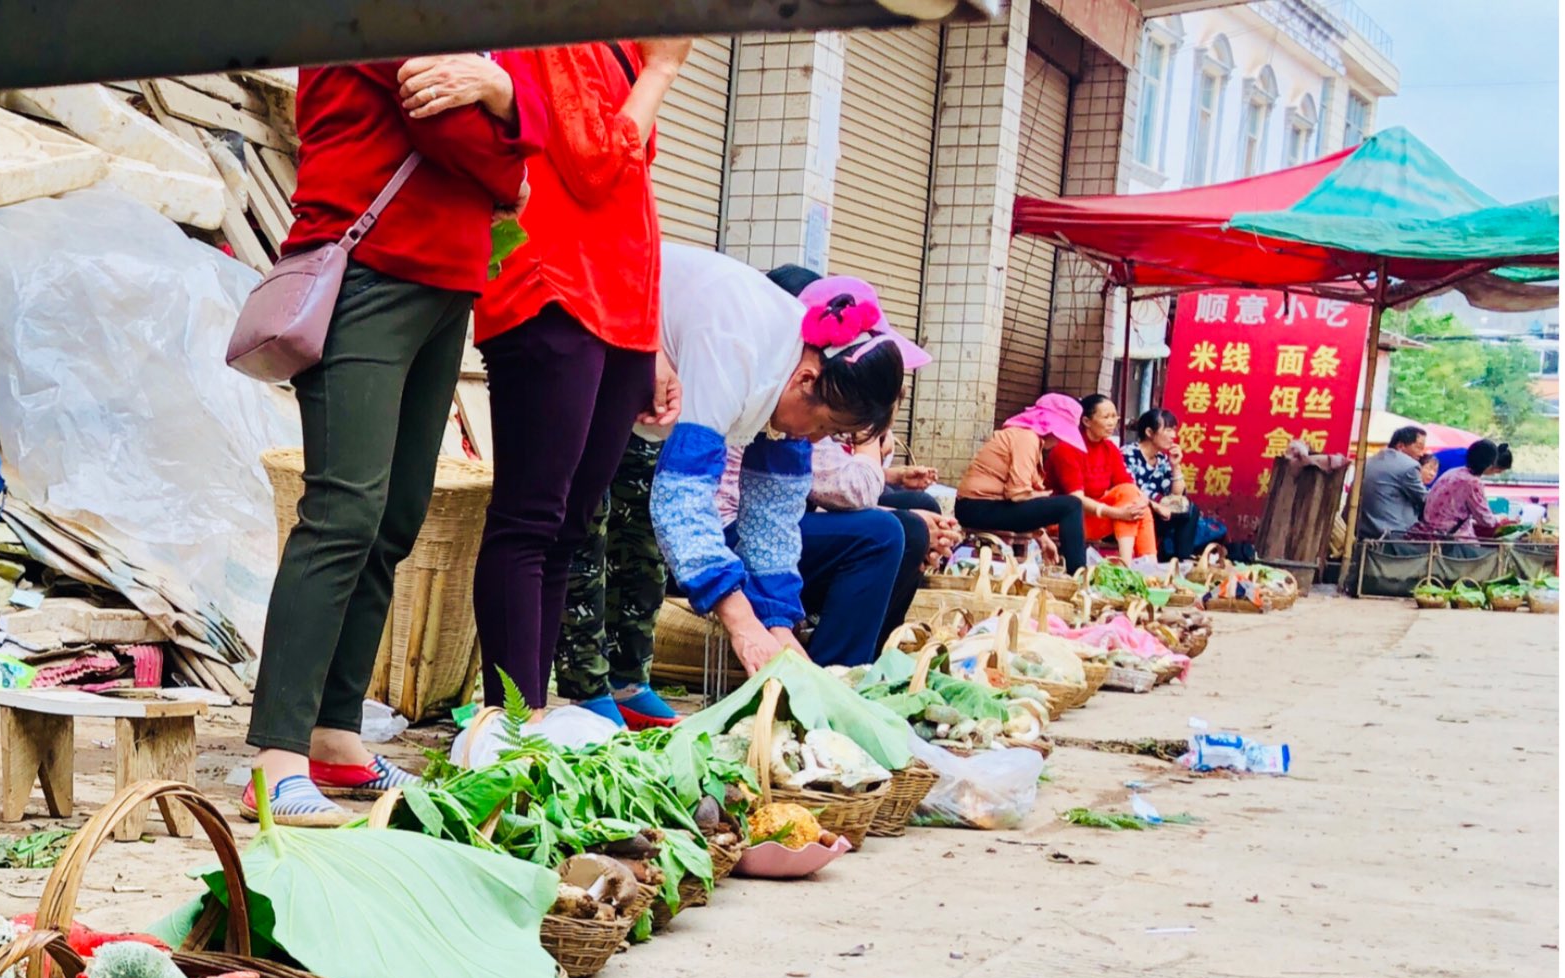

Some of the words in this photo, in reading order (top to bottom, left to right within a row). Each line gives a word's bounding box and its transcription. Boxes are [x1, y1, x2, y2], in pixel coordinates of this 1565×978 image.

[1194, 293, 1349, 327] 顺意小吃
[1188, 340, 1251, 374] 米线
[1276, 344, 1341, 378] 面条
[1183, 382, 1246, 415] 卷粉
[1269, 385, 1334, 419] 饵丝
[1177, 422, 1239, 455] 饺子
